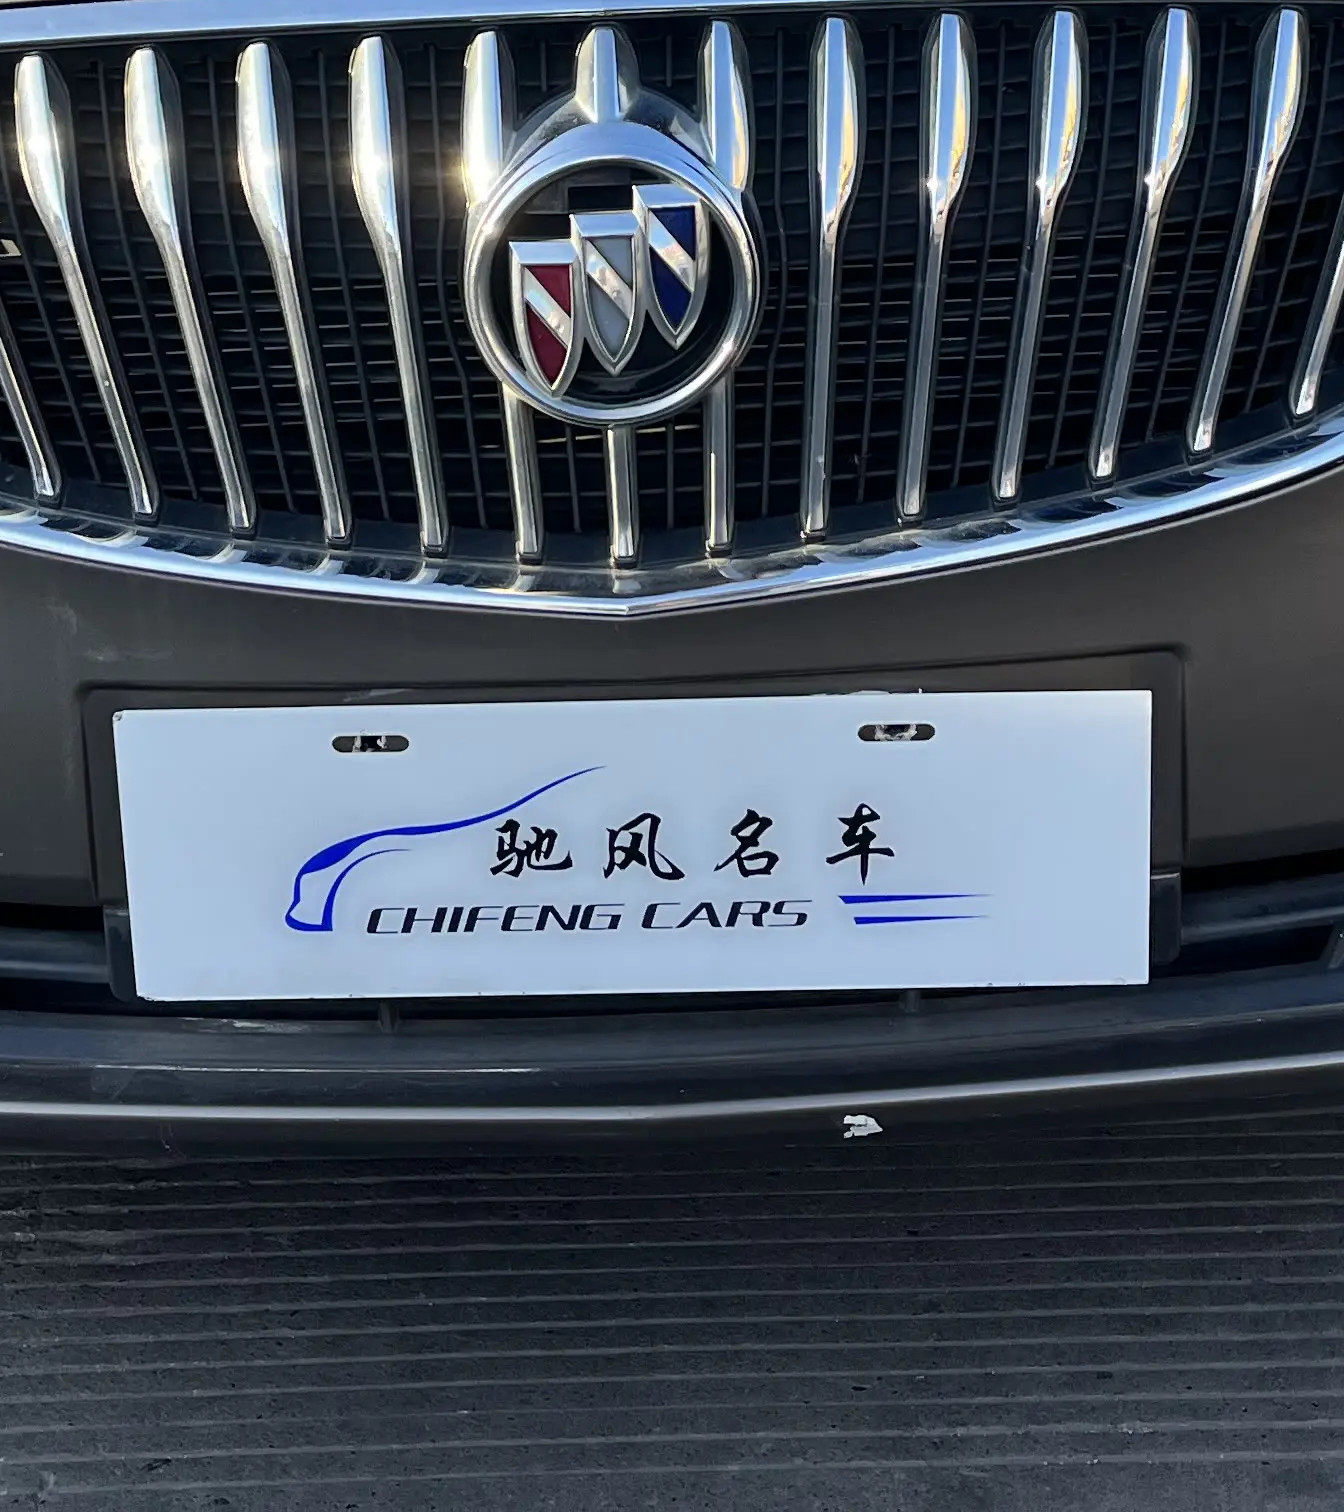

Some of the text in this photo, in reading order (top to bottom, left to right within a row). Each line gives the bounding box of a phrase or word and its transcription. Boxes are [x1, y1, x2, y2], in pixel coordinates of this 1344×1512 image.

[489, 802, 895, 885] 驰风名车
[366, 899, 813, 935] CHIFENG CARS
